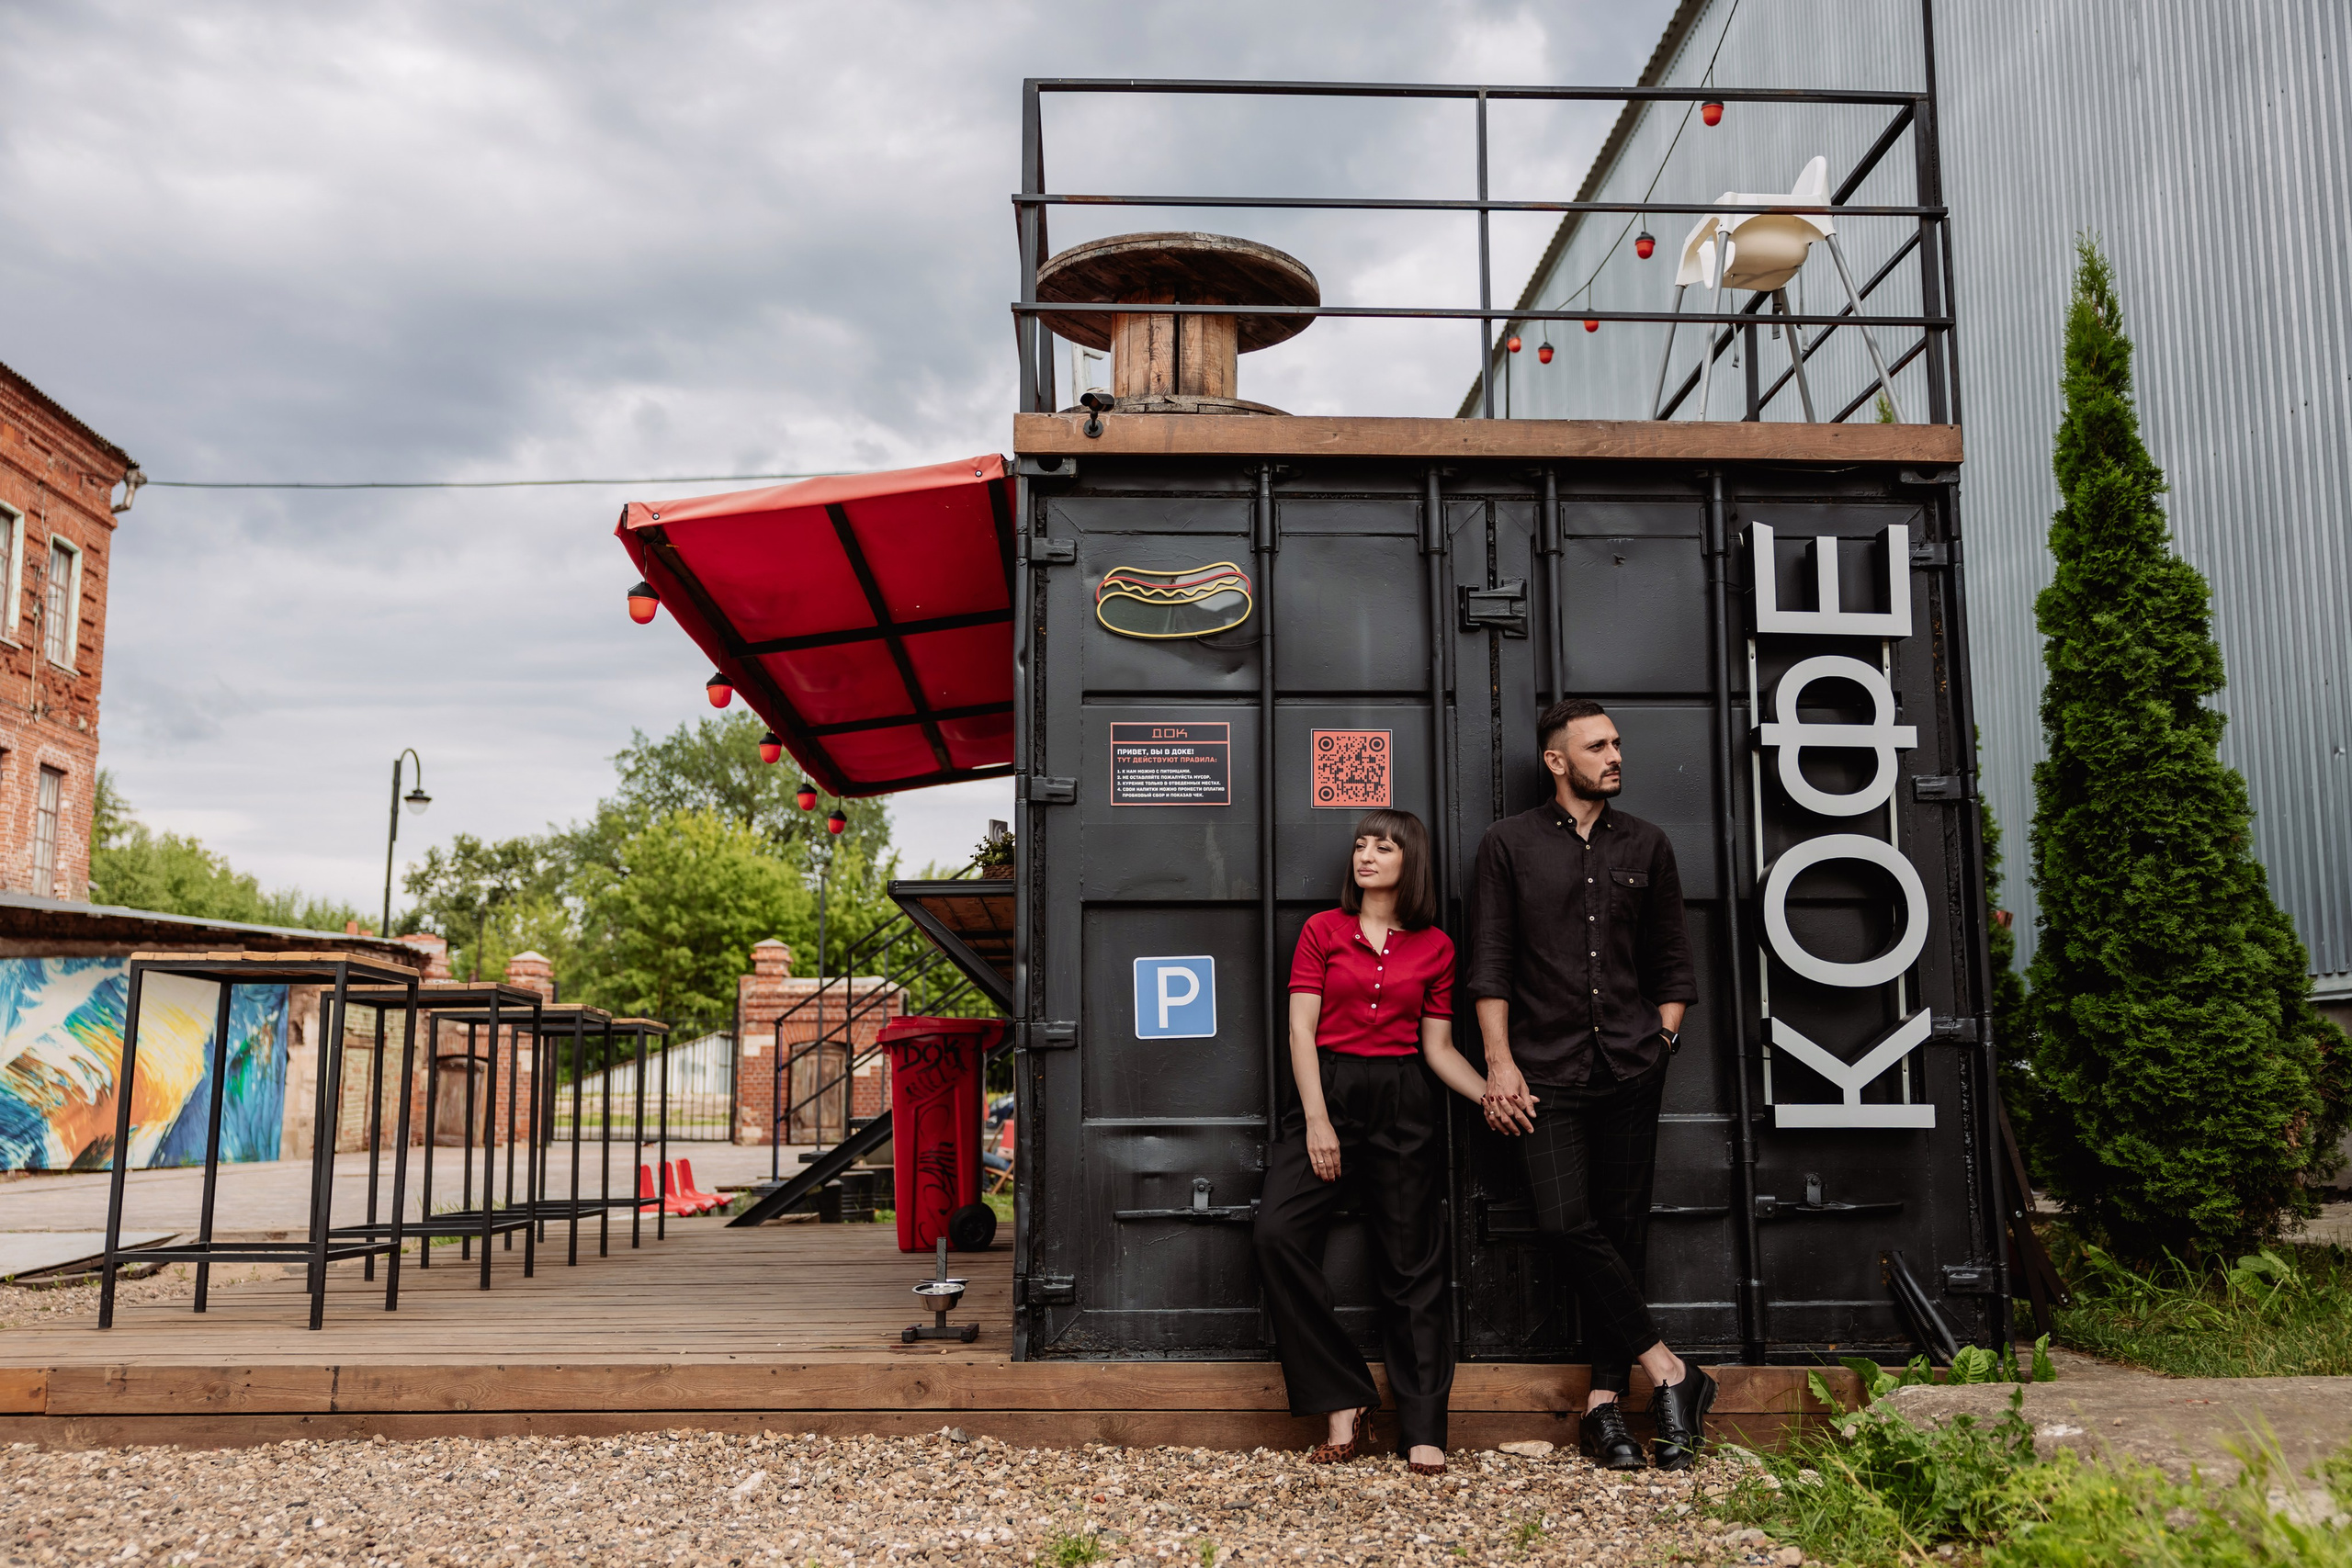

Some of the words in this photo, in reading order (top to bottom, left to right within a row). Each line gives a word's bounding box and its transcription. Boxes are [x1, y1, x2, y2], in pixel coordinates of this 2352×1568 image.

[1151, 728, 1188, 739] ДОК
[1752, 522, 1936, 1129] КОФЕ
[1158, 966, 1200, 1029] P
